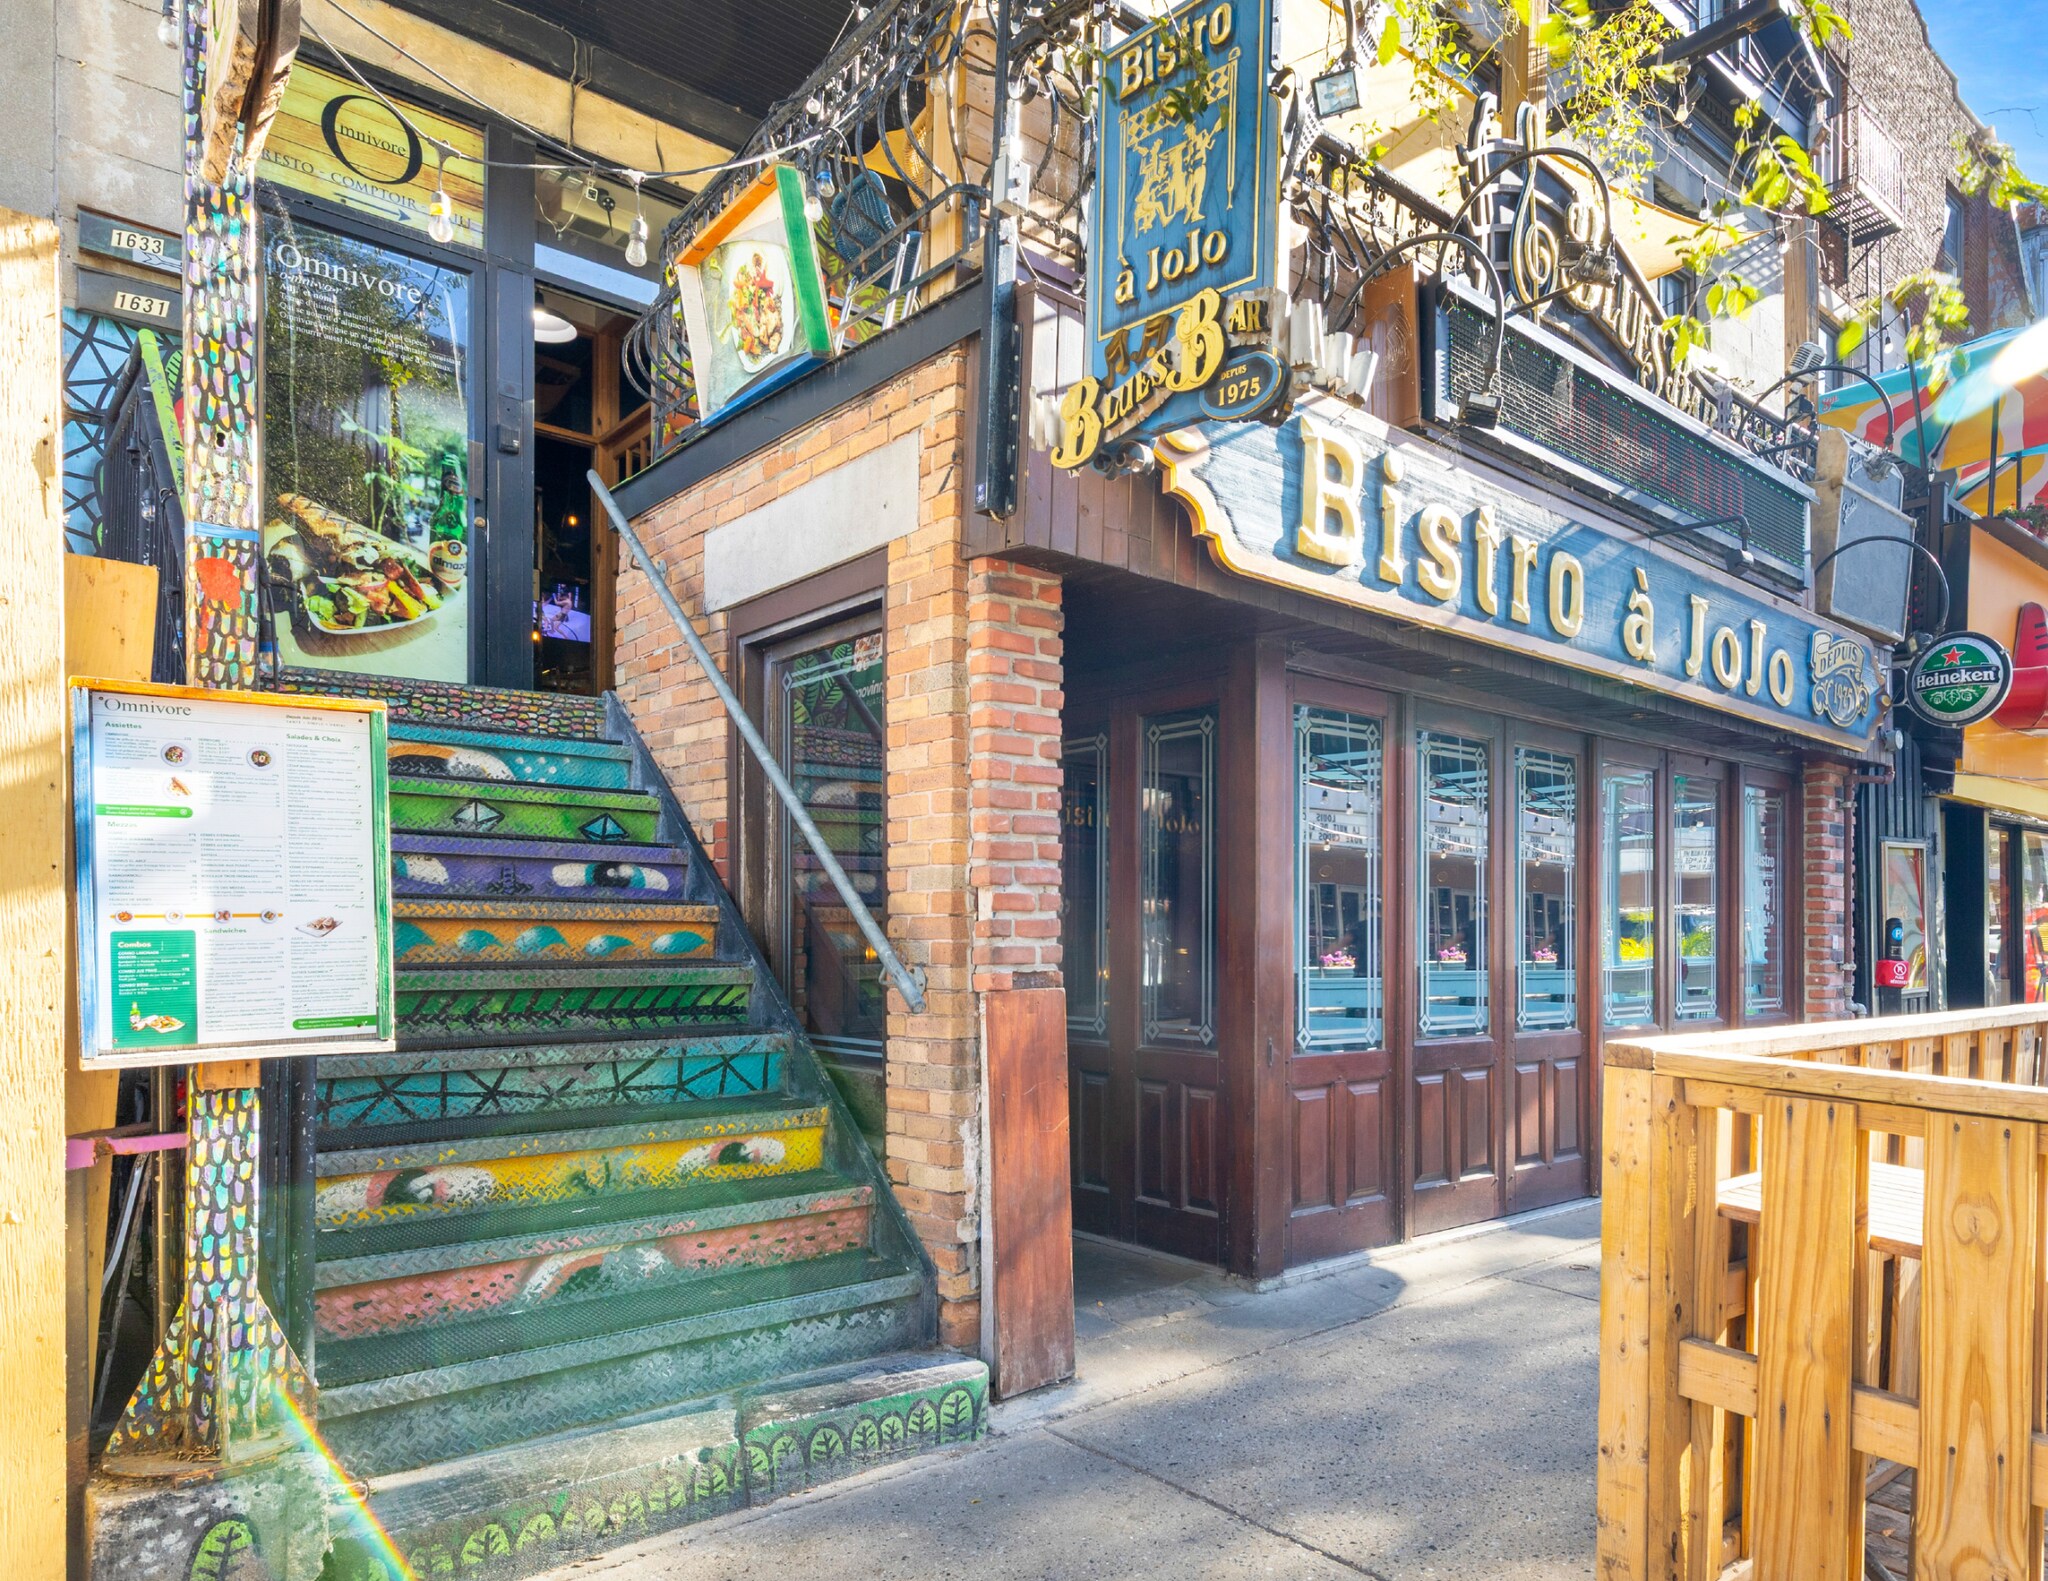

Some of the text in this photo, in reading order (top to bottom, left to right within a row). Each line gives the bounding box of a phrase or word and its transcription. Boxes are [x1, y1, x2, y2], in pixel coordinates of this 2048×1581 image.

[1120, 3, 1232, 99] Bistro
[321, 95, 423, 184] Omnivore
[262, 148, 315, 174] RESTO
[331, 171, 418, 210] COMPTOIR
[116, 231, 162, 254] 1633
[276, 244, 422, 305] Omnivore
[1114, 228, 1227, 305] à JoJo
[119, 294, 165, 316] 1631
[1051, 287, 1262, 469] BLUES BAR
[1219, 363, 1247, 381] DEPUIS
[1218, 377, 1261, 407] 1975
[1297, 414, 1795, 708] Bistro à JoJo
[1819, 643, 1858, 671] DEPUIS
[1916, 669, 1996, 689] Heineken
[104, 697, 192, 716] Omnivore
[1833, 680, 1854, 713] 1975
[104, 721, 142, 729] Assiettes
[286, 733, 313, 741] Salades
[203, 926, 247, 934] Sandwiches
[117, 941, 152, 949] Combos
